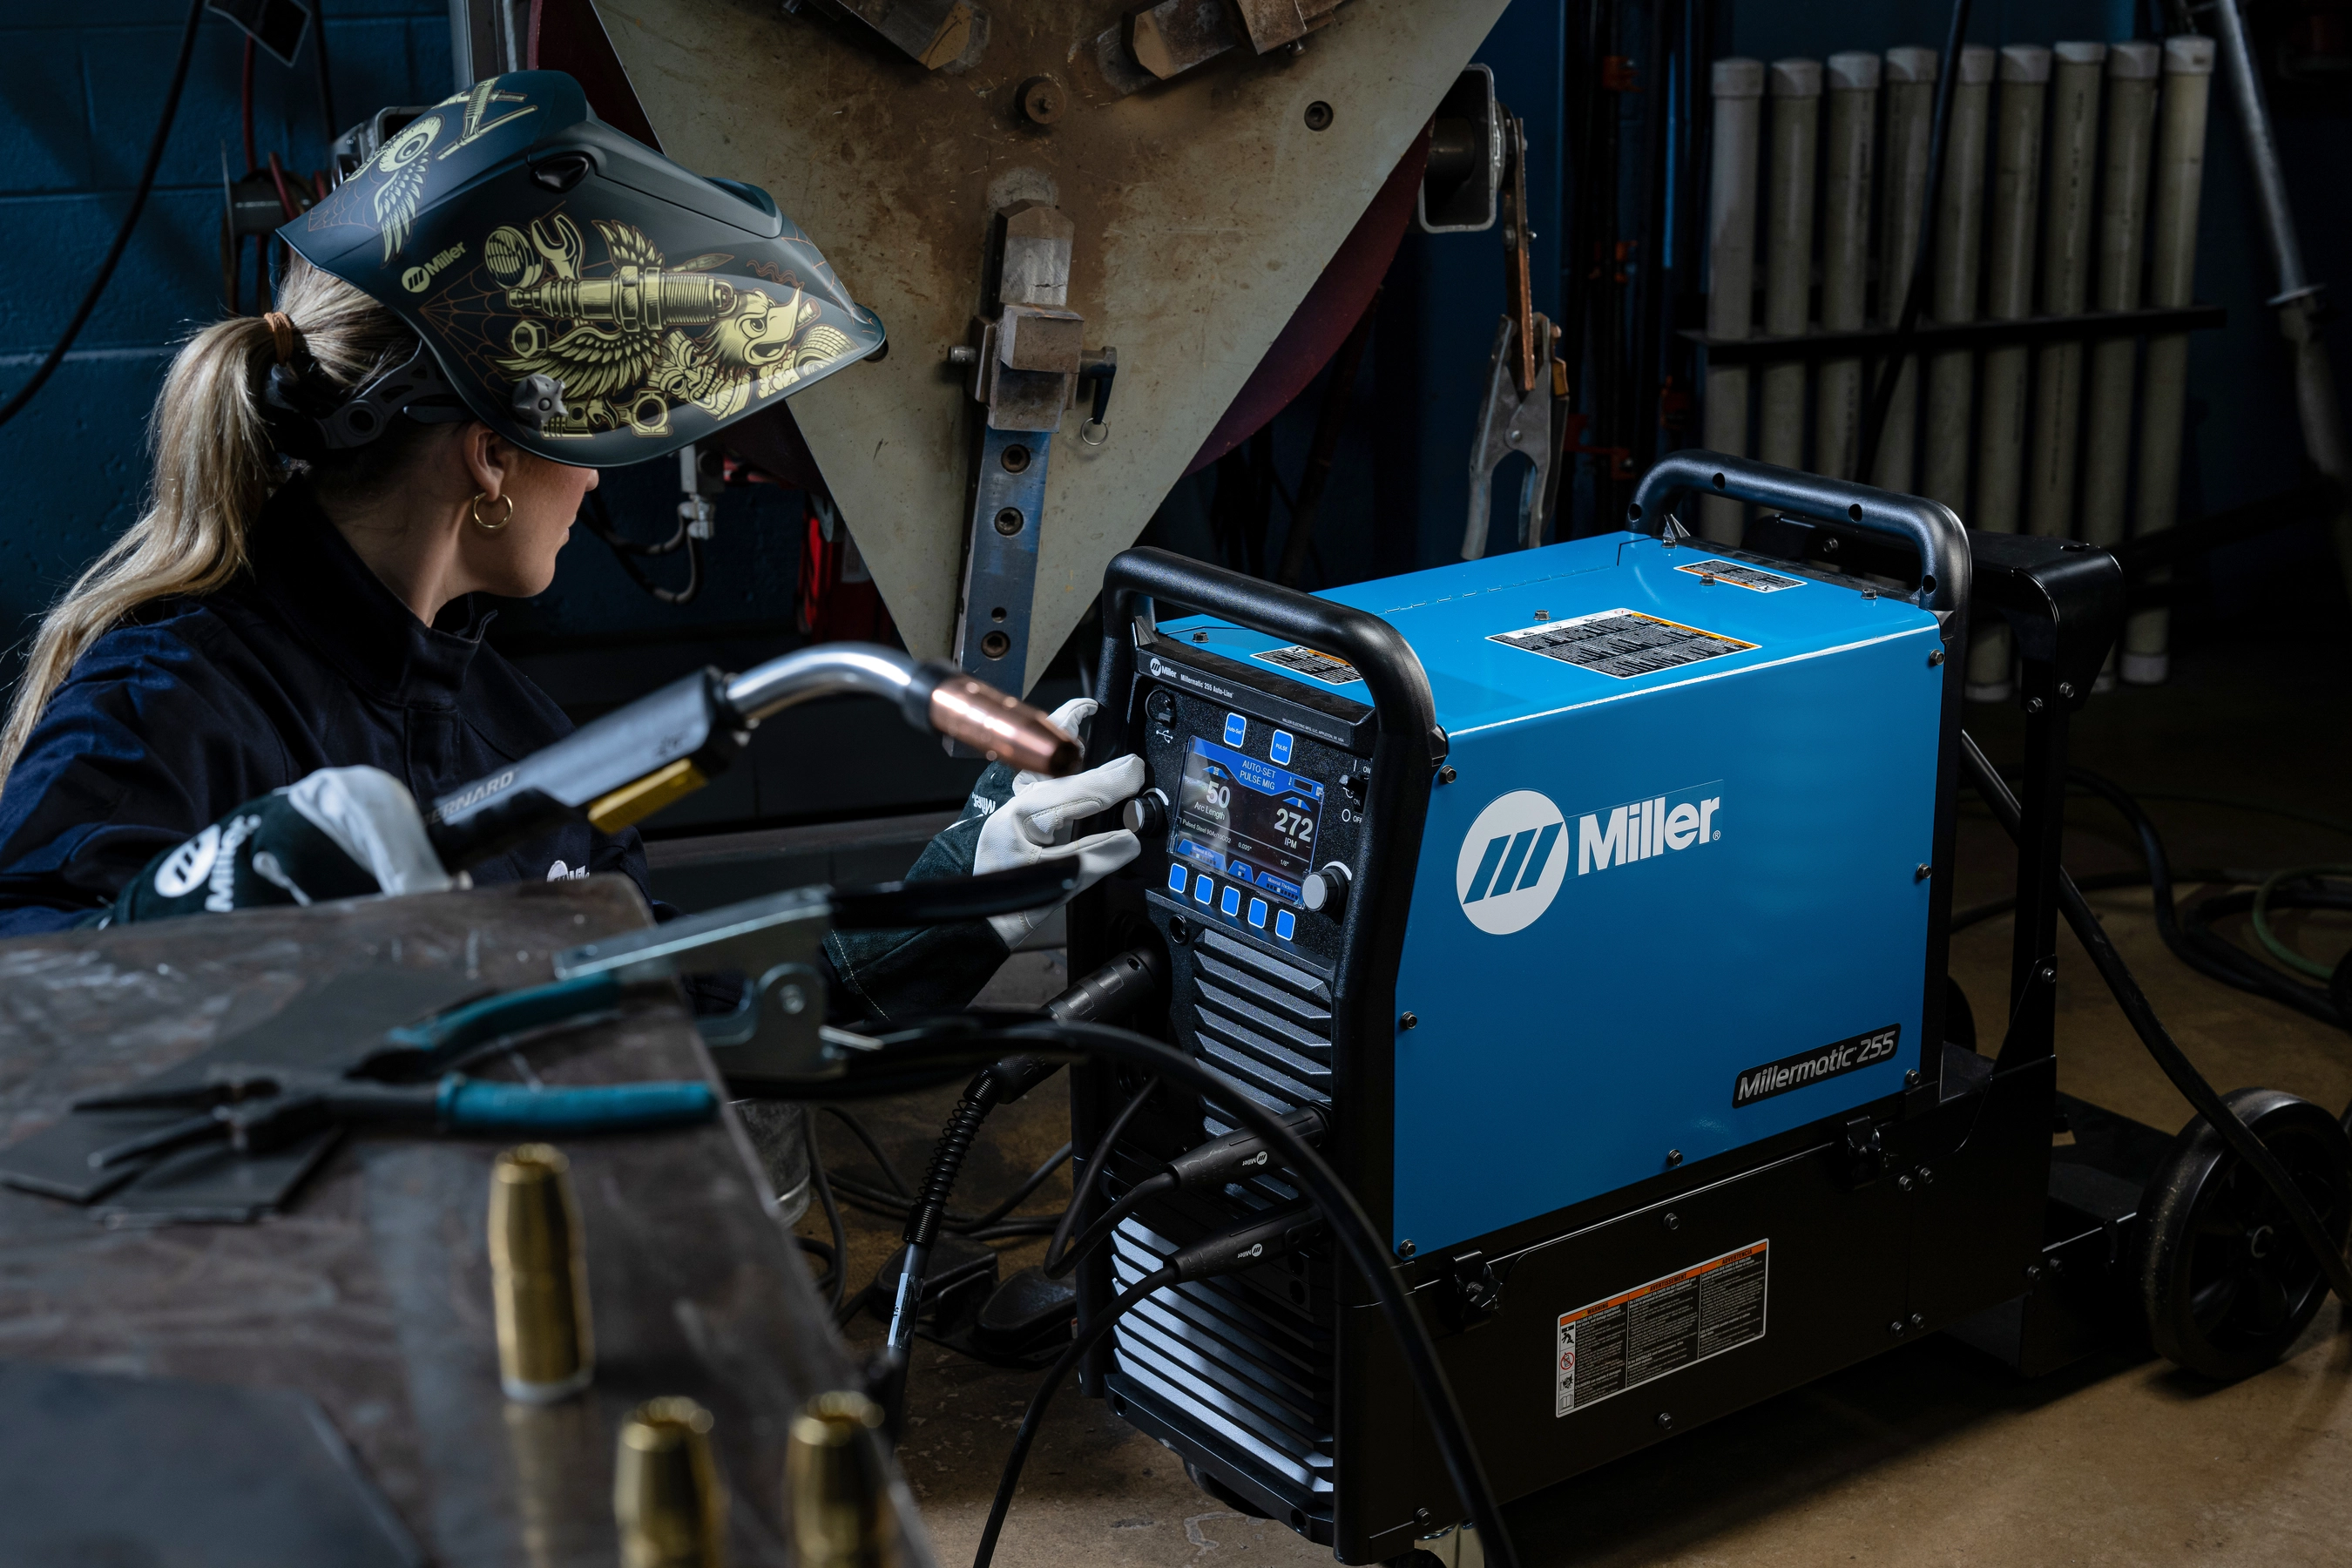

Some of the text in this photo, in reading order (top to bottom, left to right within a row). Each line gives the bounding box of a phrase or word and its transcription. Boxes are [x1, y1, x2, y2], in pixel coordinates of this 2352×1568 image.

[423, 241, 466, 276] Miller
[1161, 665, 1177, 679] Miller
[1204, 682, 1213, 691] 255
[1275, 743, 1288, 752] PULSE
[1242, 760, 1276, 779] AUTO-SET
[1362, 766, 1371, 774] ON
[1240, 770, 1261, 787] PULSE
[1261, 779, 1275, 791] MIG
[424, 770, 515, 826] ERNARD
[1206, 781, 1230, 808] 50
[1194, 801, 1226, 821] Arc Length
[1353, 815, 1362, 824] OFF
[1182, 819, 1196, 829] Pulsed
[1274, 808, 1314, 842] 272
[1284, 836, 1297, 850] IPM
[1738, 1031, 1896, 1100] Millermatic 255
[1721, 1248, 1753, 1264] ADVERTENCIA
[1649, 1273, 1687, 1292] AVERTISSEMENT
[1586, 1301, 1609, 1315] WARNING
